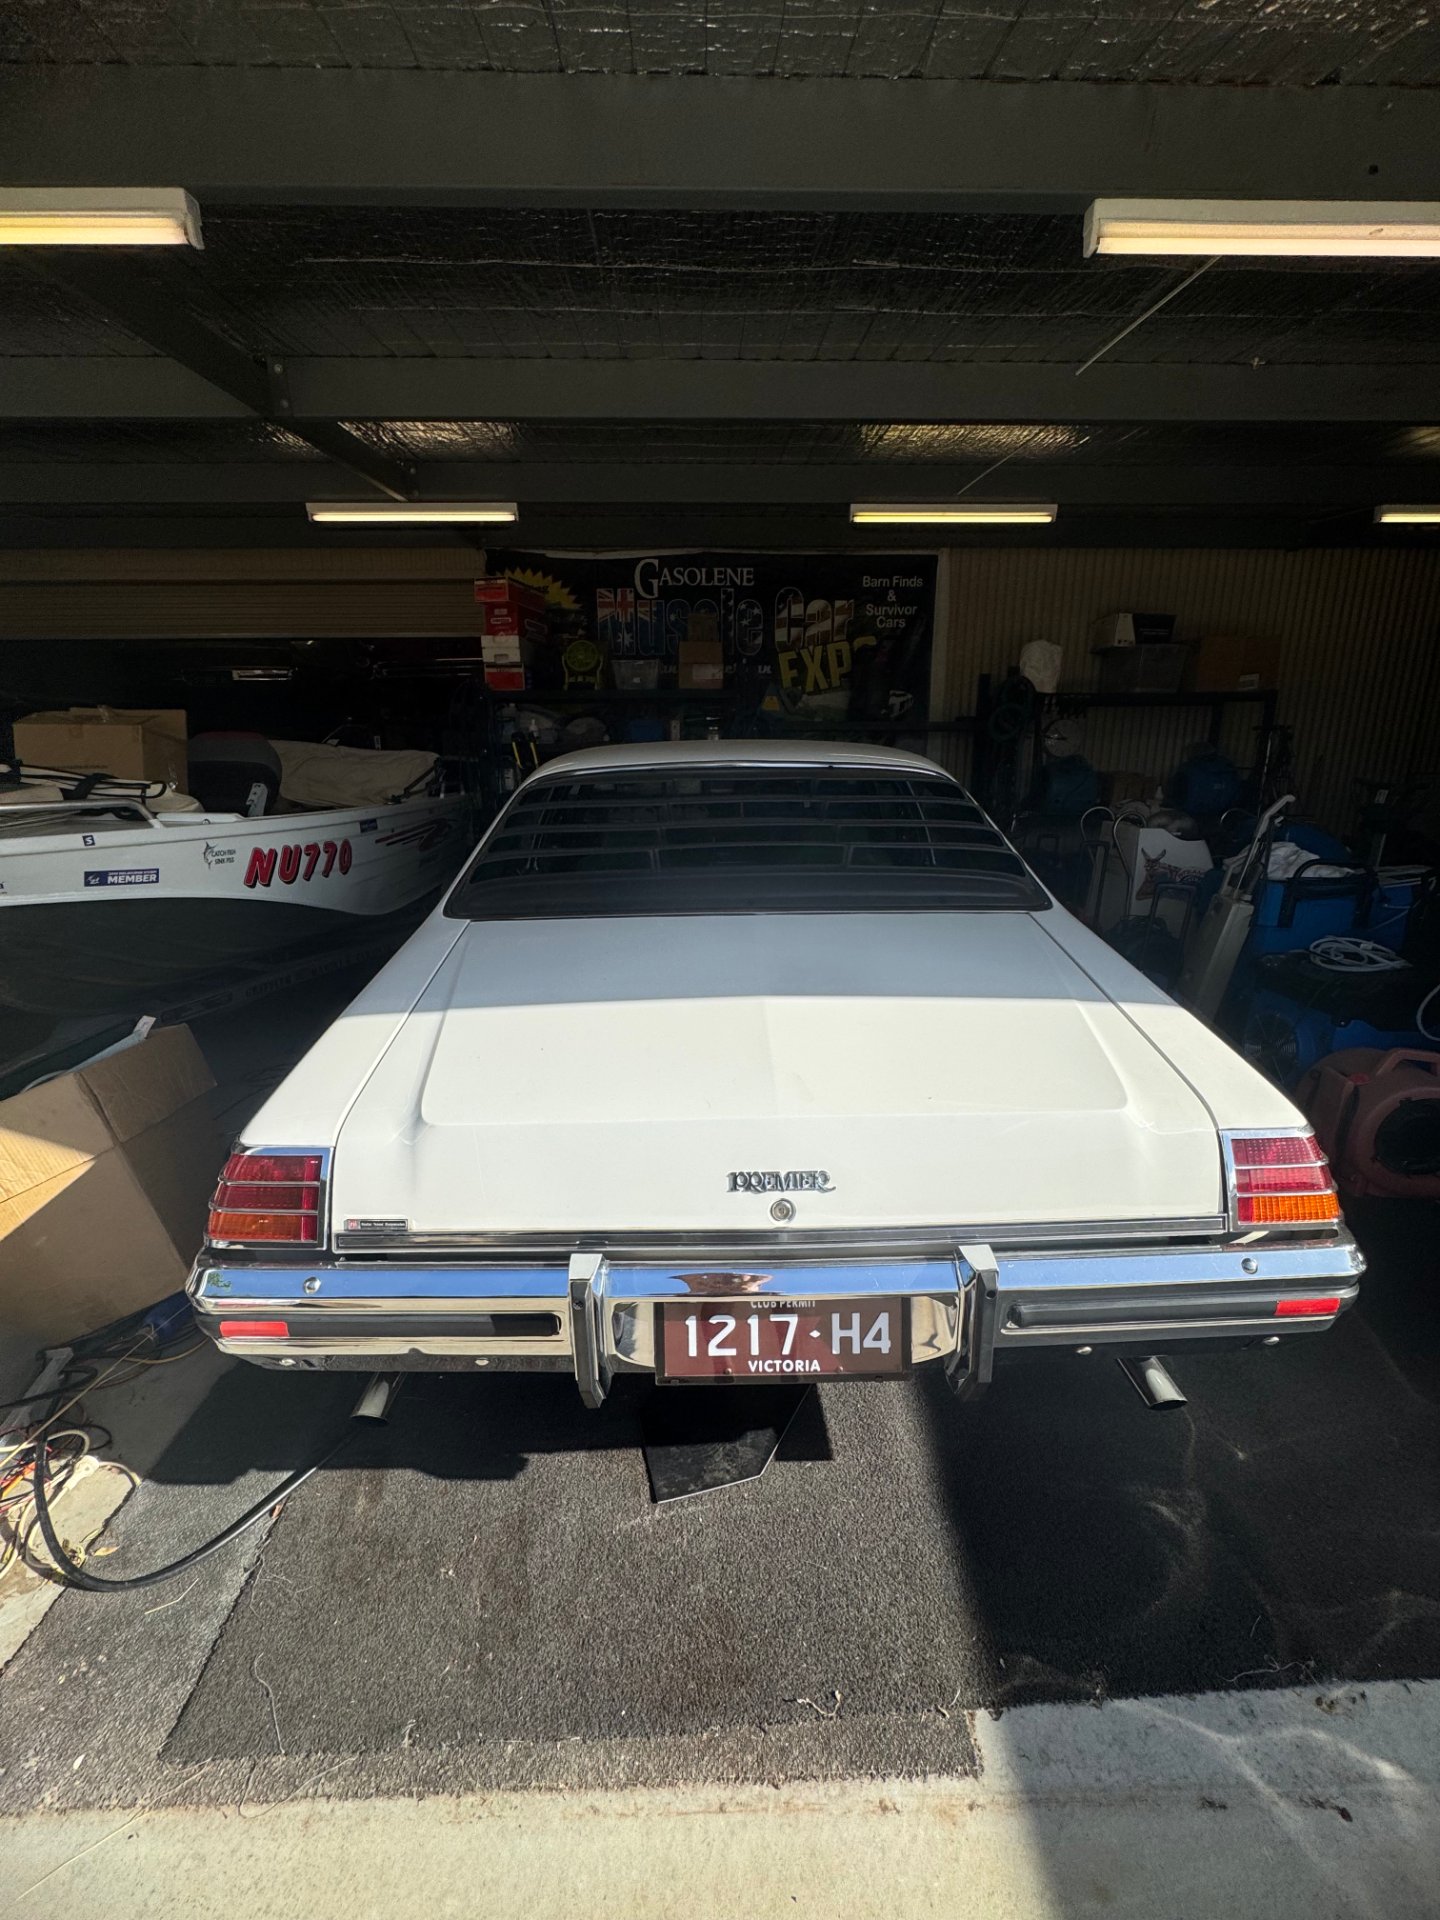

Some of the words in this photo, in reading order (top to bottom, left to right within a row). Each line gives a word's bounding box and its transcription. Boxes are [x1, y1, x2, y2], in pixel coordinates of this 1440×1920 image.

[634, 558, 755, 599] GASOLENE
[862, 576, 890, 588] Barn
[892, 576, 924, 588] Finds
[886, 591, 897, 602] &
[865, 603, 918, 616] Survivor
[774, 586, 855, 652] Car
[876, 616, 906, 629] Cars
[243, 838, 353, 889] NU770
[107, 874, 157, 884] MEMBER
[726, 1170, 836, 1194] PREMIER
[750, 1300, 777, 1309] CLUB
[779, 1300, 816, 1308] PERMIT
[747, 1359, 821, 1373] VICTORIA
